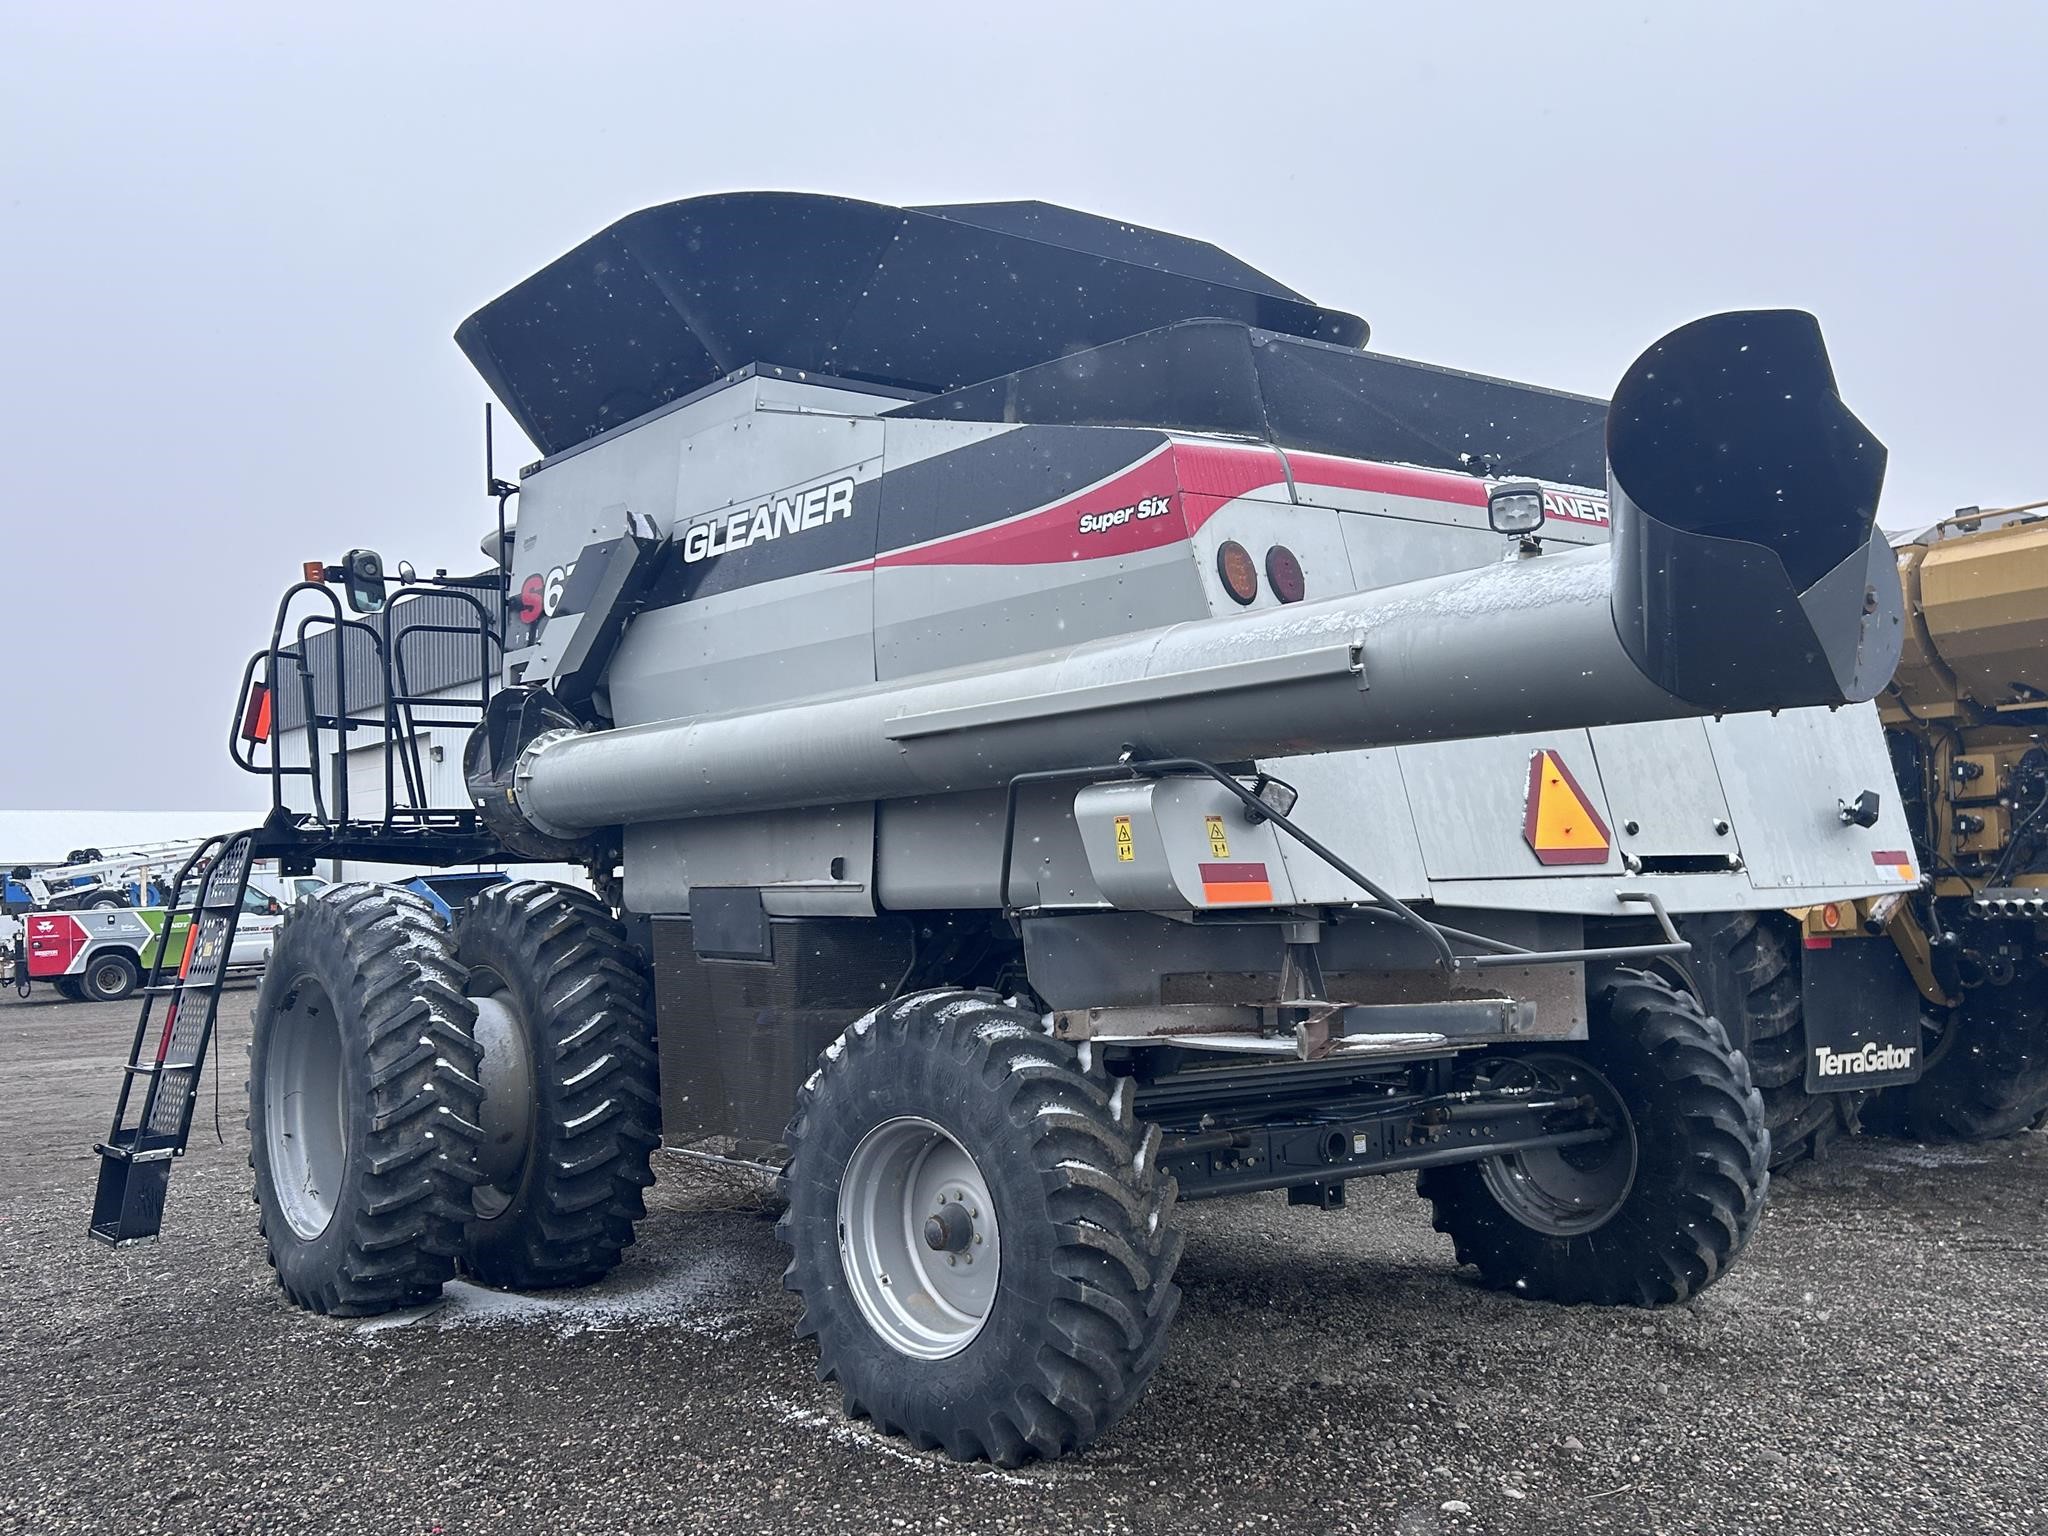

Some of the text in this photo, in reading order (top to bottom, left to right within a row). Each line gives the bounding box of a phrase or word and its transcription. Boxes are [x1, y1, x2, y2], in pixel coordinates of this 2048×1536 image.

[683, 477, 855, 563] GLEANER
[1079, 496, 1171, 533] Super Six
[1543, 492, 1609, 523] ANER
[519, 564, 578, 624] S6
[1815, 1042, 1917, 1076] TerraGator
